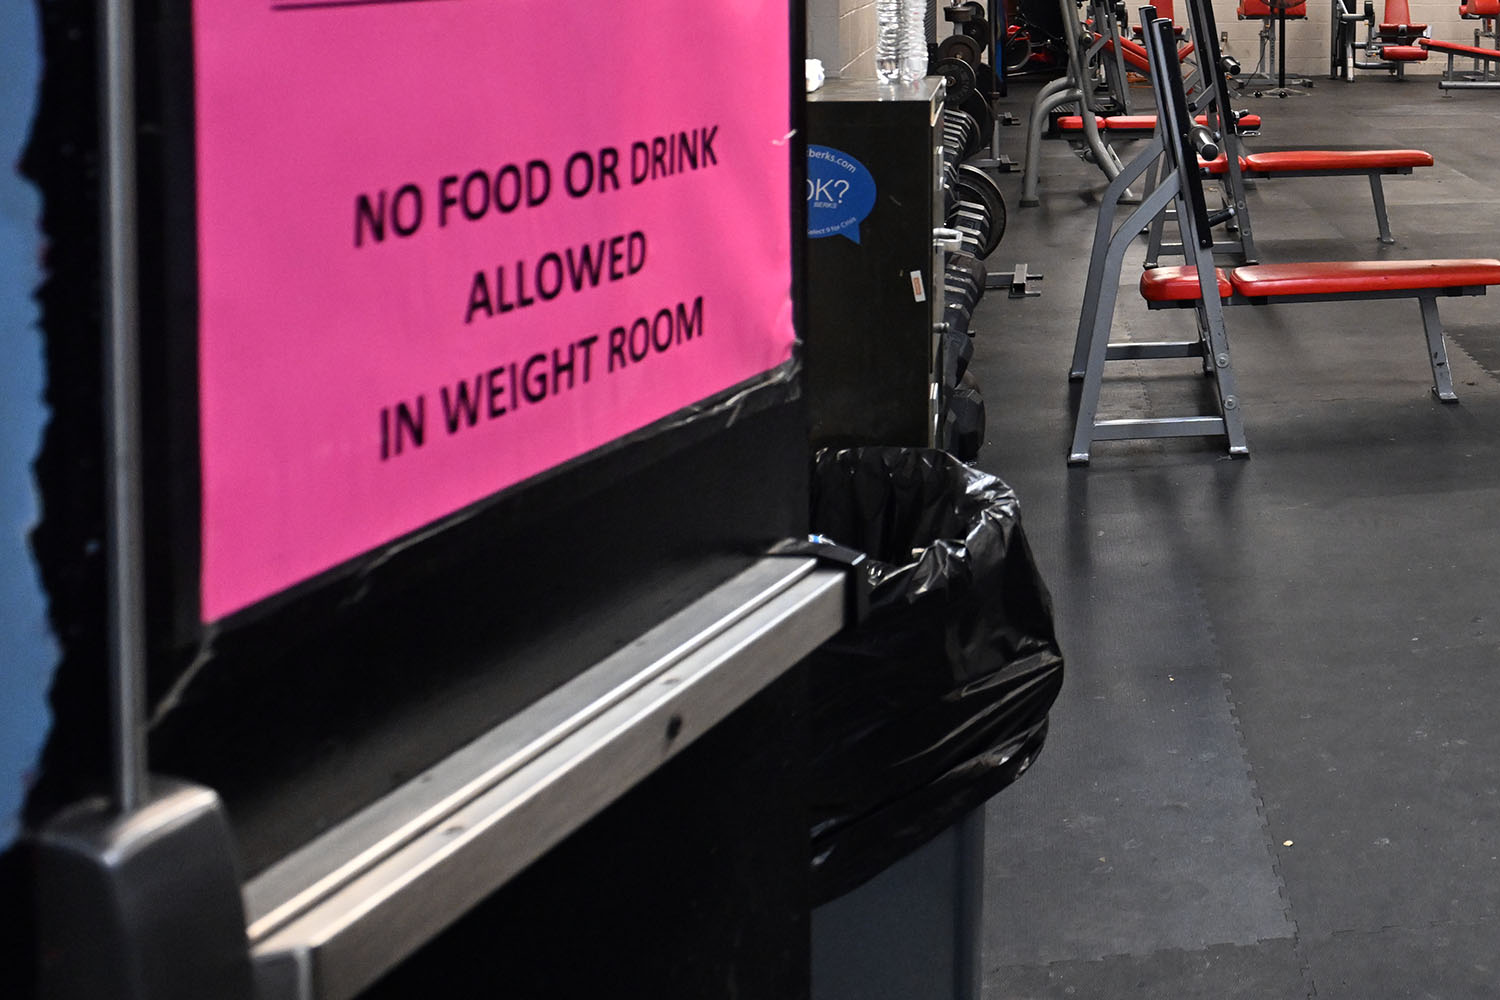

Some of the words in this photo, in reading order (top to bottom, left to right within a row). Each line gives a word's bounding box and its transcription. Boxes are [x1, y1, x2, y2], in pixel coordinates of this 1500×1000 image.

[353, 185, 424, 249] NO
[438, 159, 551, 229] FOOD
[564, 147, 620, 200] OR
[630, 125, 720, 188] DRINK
[806, 148, 857, 173] berks.com
[463, 229, 648, 325] ALLOWED
[380, 395, 426, 462] IN
[441, 335, 600, 436] WEIGHT
[607, 296, 705, 375] ROOM
